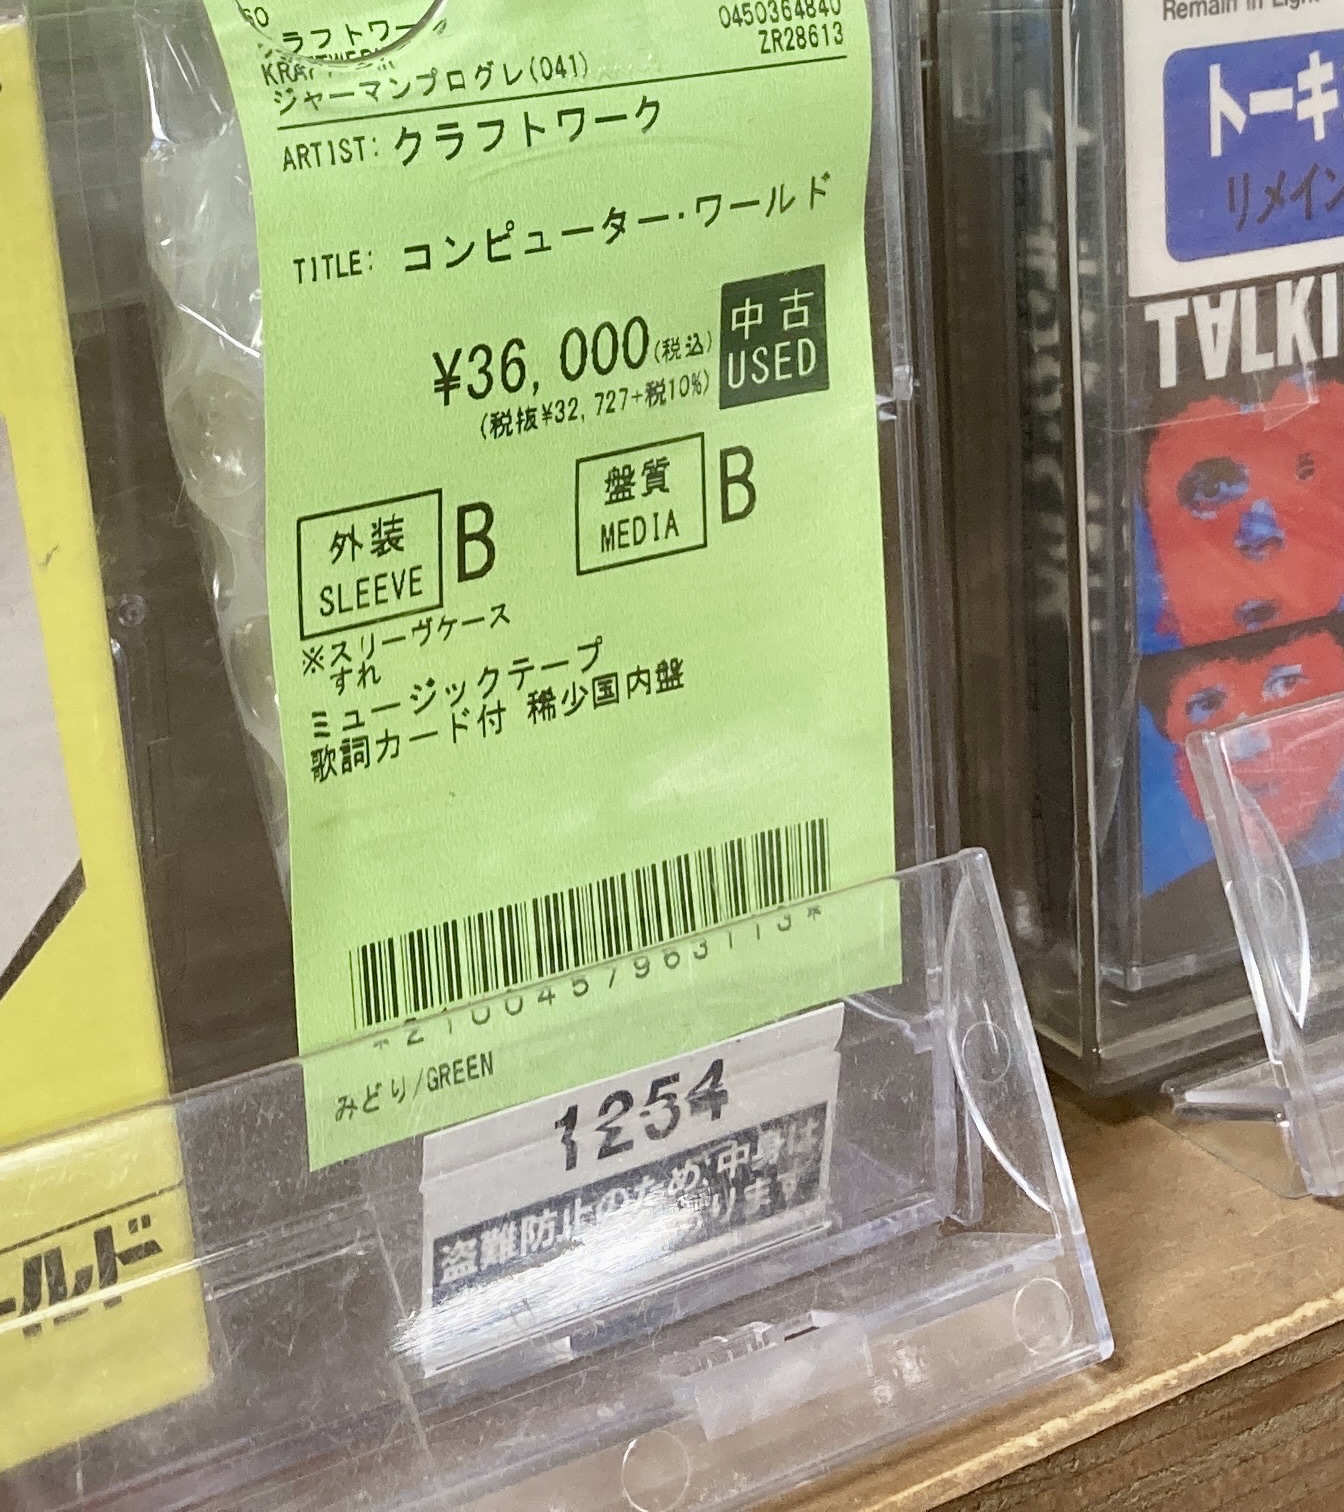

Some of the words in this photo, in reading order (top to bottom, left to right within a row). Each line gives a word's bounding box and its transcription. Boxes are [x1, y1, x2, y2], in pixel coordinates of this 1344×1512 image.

[759, 23, 845, 56] ZR28613
[272, 51, 589, 117] ジャーマンプログレ(041)
[282, 134, 379, 172] ARTIST:
[394, 94, 662, 167] クラフトワーク
[293, 249, 373, 284] TITLE:
[404, 171, 832, 272] コンピューター・ワールド
[729, 288, 815, 341] 中古
[432, 315, 651, 407] ¥36,000
[653, 330, 714, 365] (税込)
[726, 336, 818, 390] USED
[603, 457, 671, 506] 盤質
[721, 444, 757, 525] B
[329, 514, 406, 565] 外装
[457, 501, 496, 584] B
[600, 508, 681, 553] MEDIA
[319, 565, 425, 619] SLEEVE
[311, 635, 605, 740] ミュージックテープ
[330, 661, 383, 696] すれ
[311, 698, 507, 783] 歌詞カード付
[527, 657, 686, 725] 稀少国内盤
[334, 1050, 496, 1122] みどり/GREEN
[555, 1058, 729, 1172] 1254
